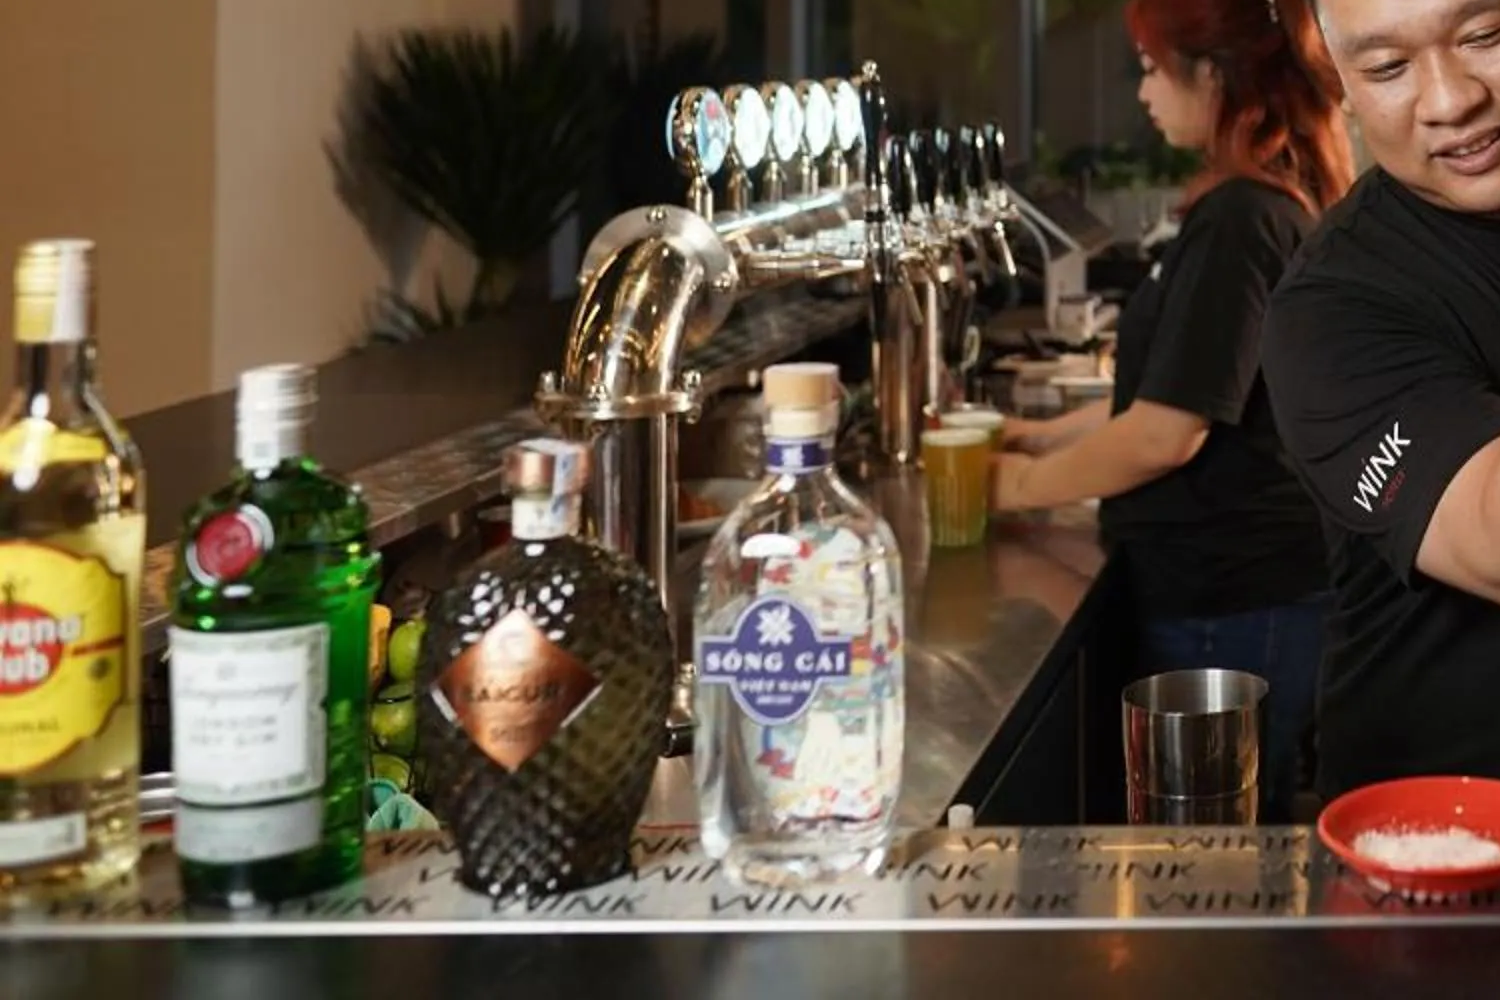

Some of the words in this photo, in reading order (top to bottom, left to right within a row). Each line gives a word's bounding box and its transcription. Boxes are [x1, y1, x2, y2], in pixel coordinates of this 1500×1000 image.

[1353, 421, 1411, 512] WINK
[490, 893, 650, 914] WINK
[711, 892, 866, 913] WINK
[928, 892, 1080, 913] WINK
